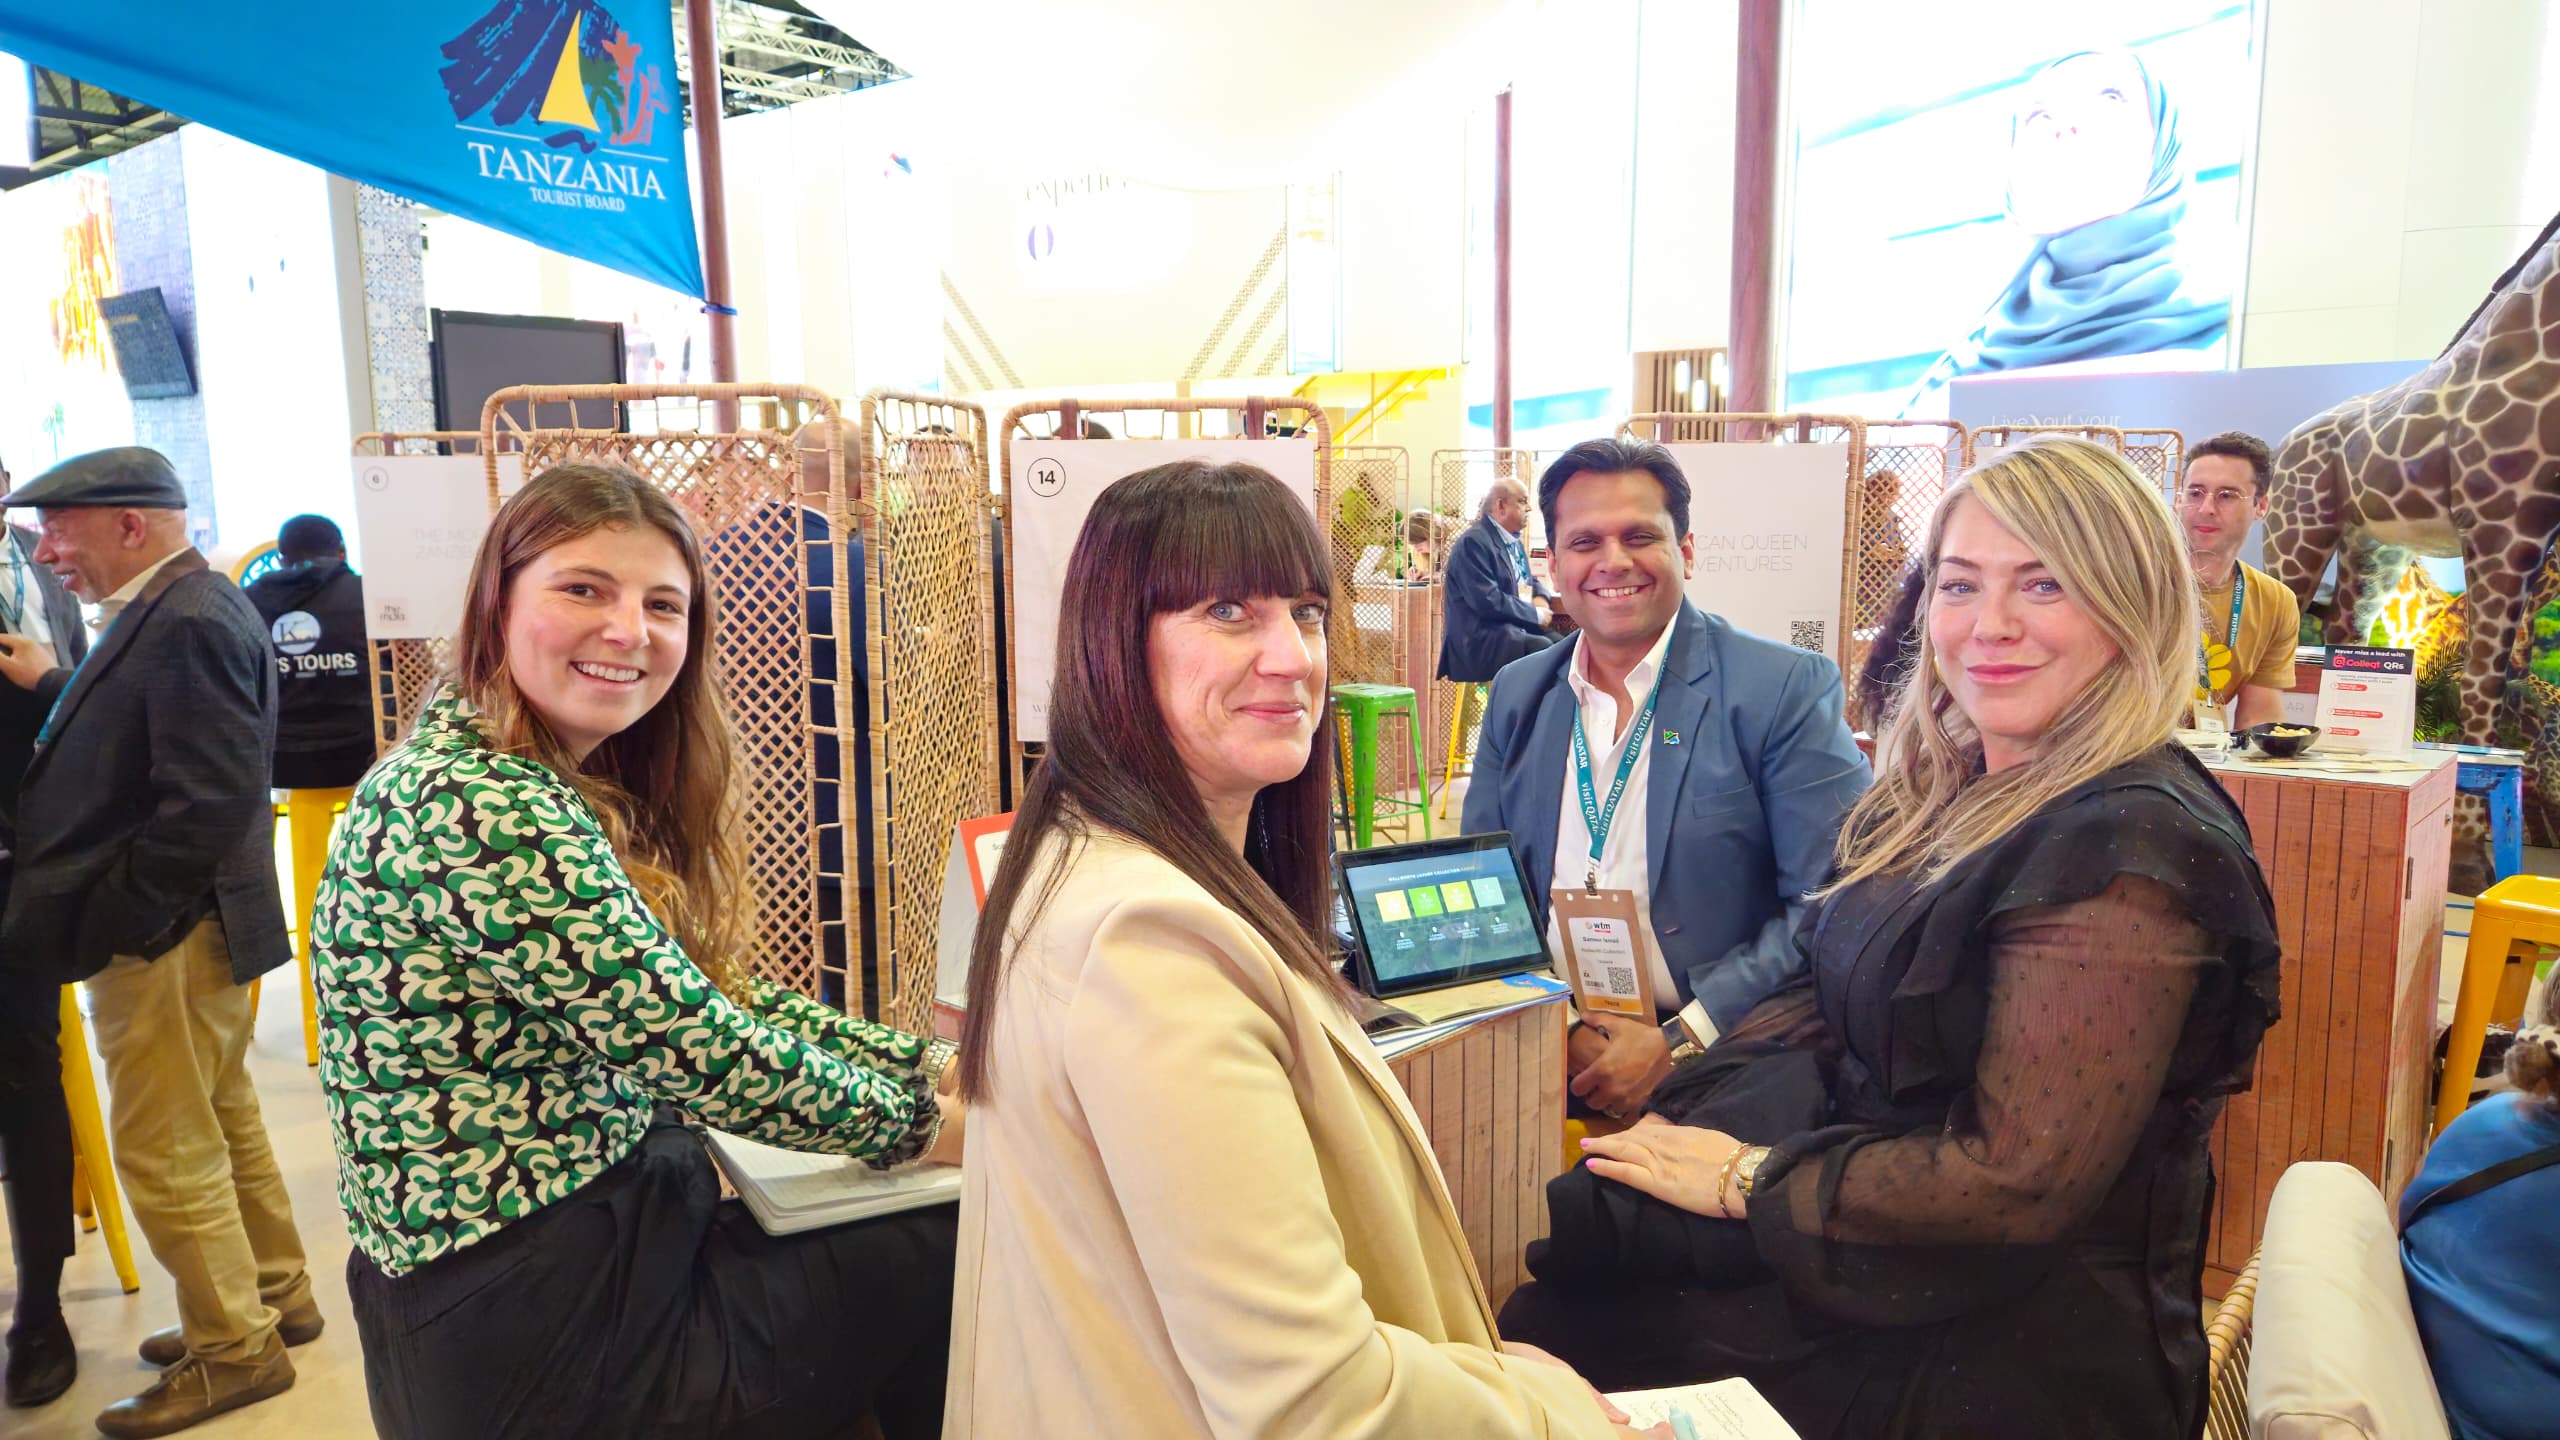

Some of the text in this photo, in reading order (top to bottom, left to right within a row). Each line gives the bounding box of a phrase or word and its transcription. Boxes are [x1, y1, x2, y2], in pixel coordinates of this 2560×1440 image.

[467, 141, 667, 201] TANZANIA
[529, 187, 626, 212] TOURIST BOARD
[1038, 470, 1056, 485] 14
[1741, 534, 1808, 551] QUEEN
[1695, 555, 1793, 572] VENTURES
[294, 652, 358, 672] TOURS
[2383, 661, 2405, 670] QRs
[1593, 921, 1611, 930] wtm
